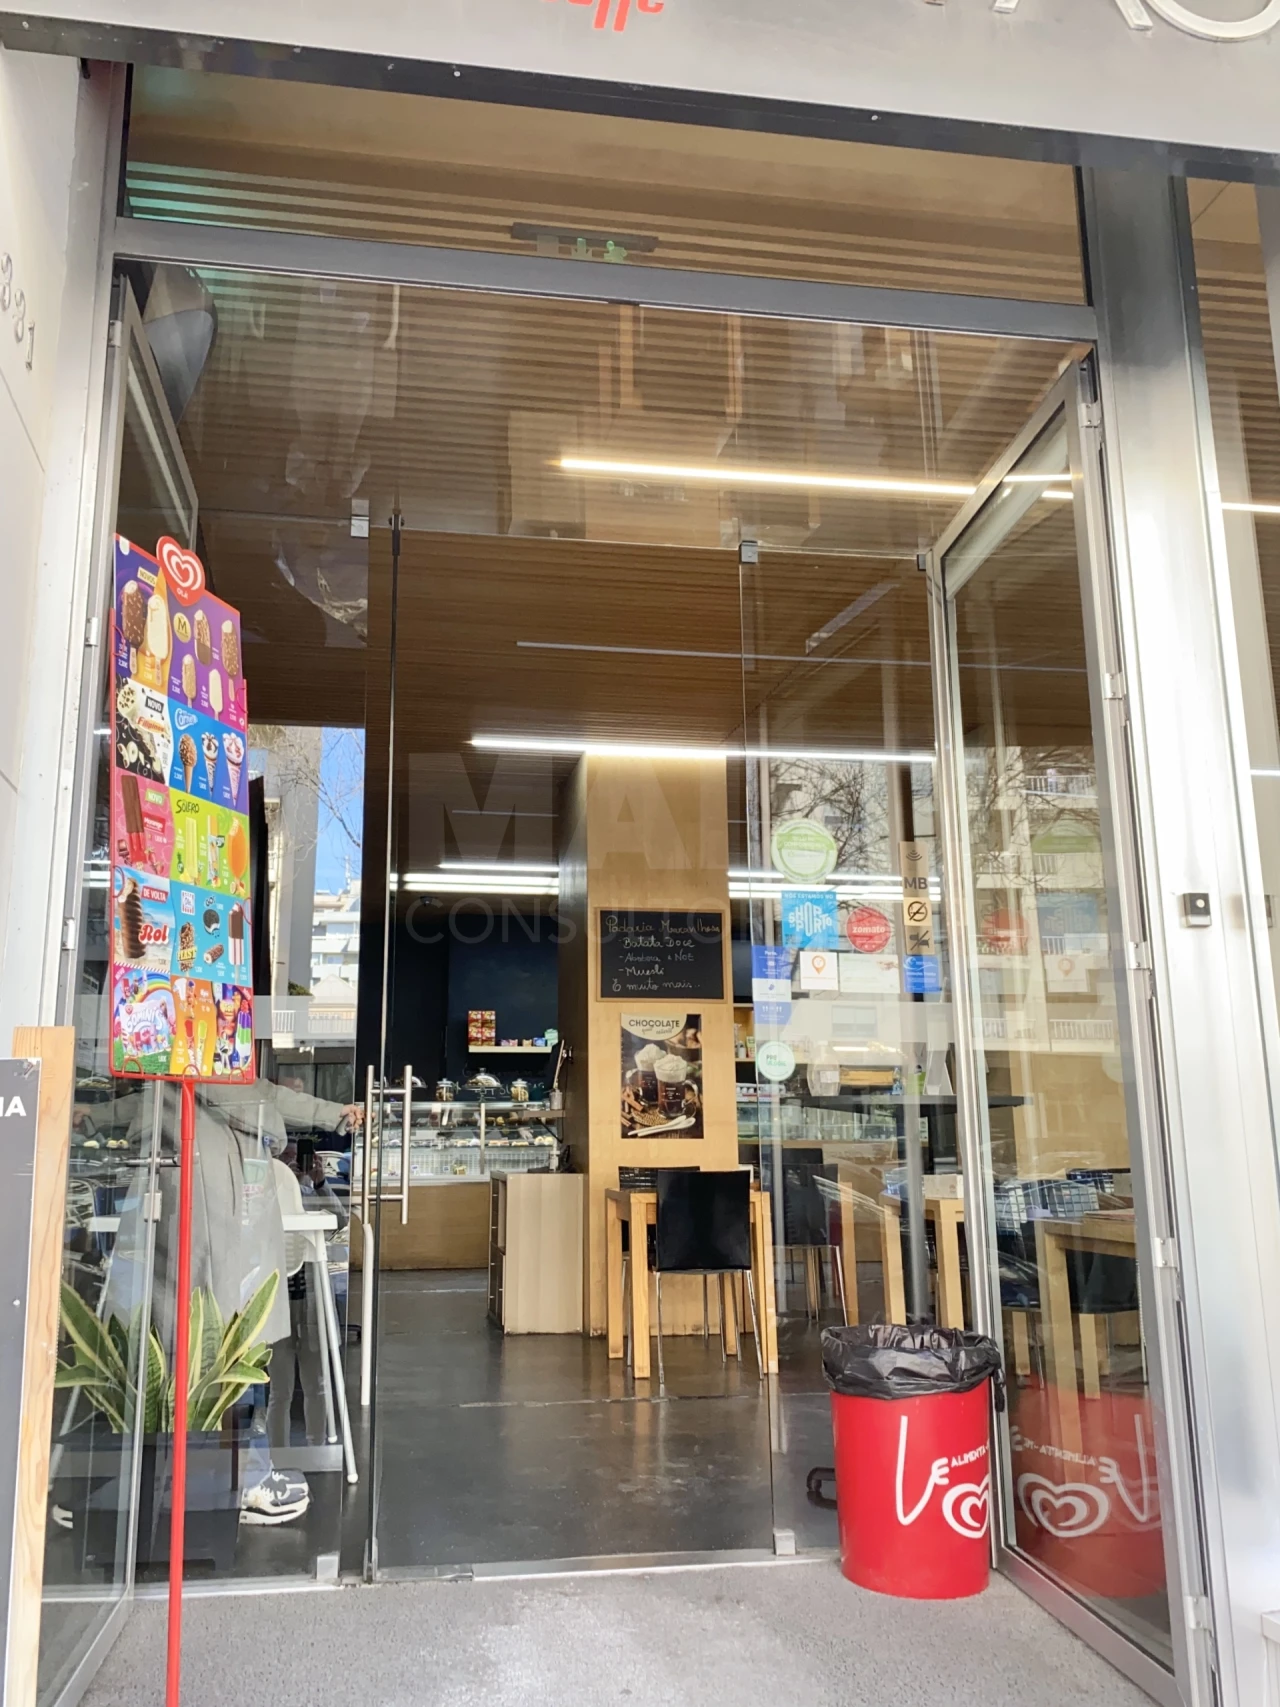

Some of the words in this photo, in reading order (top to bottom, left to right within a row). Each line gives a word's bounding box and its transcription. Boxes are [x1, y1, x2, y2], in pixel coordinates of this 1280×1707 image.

[147, 697, 162, 712] NOVO
[175, 799, 200, 814] SOLERO
[903, 876, 928, 890] MB
[151, 889, 167, 902] VOLTA
[140, 924, 168, 943] Rol
[852, 925, 886, 934] zomato
[626, 977, 659, 990] muito
[628, 1018, 680, 1030] CHOCOLATE
